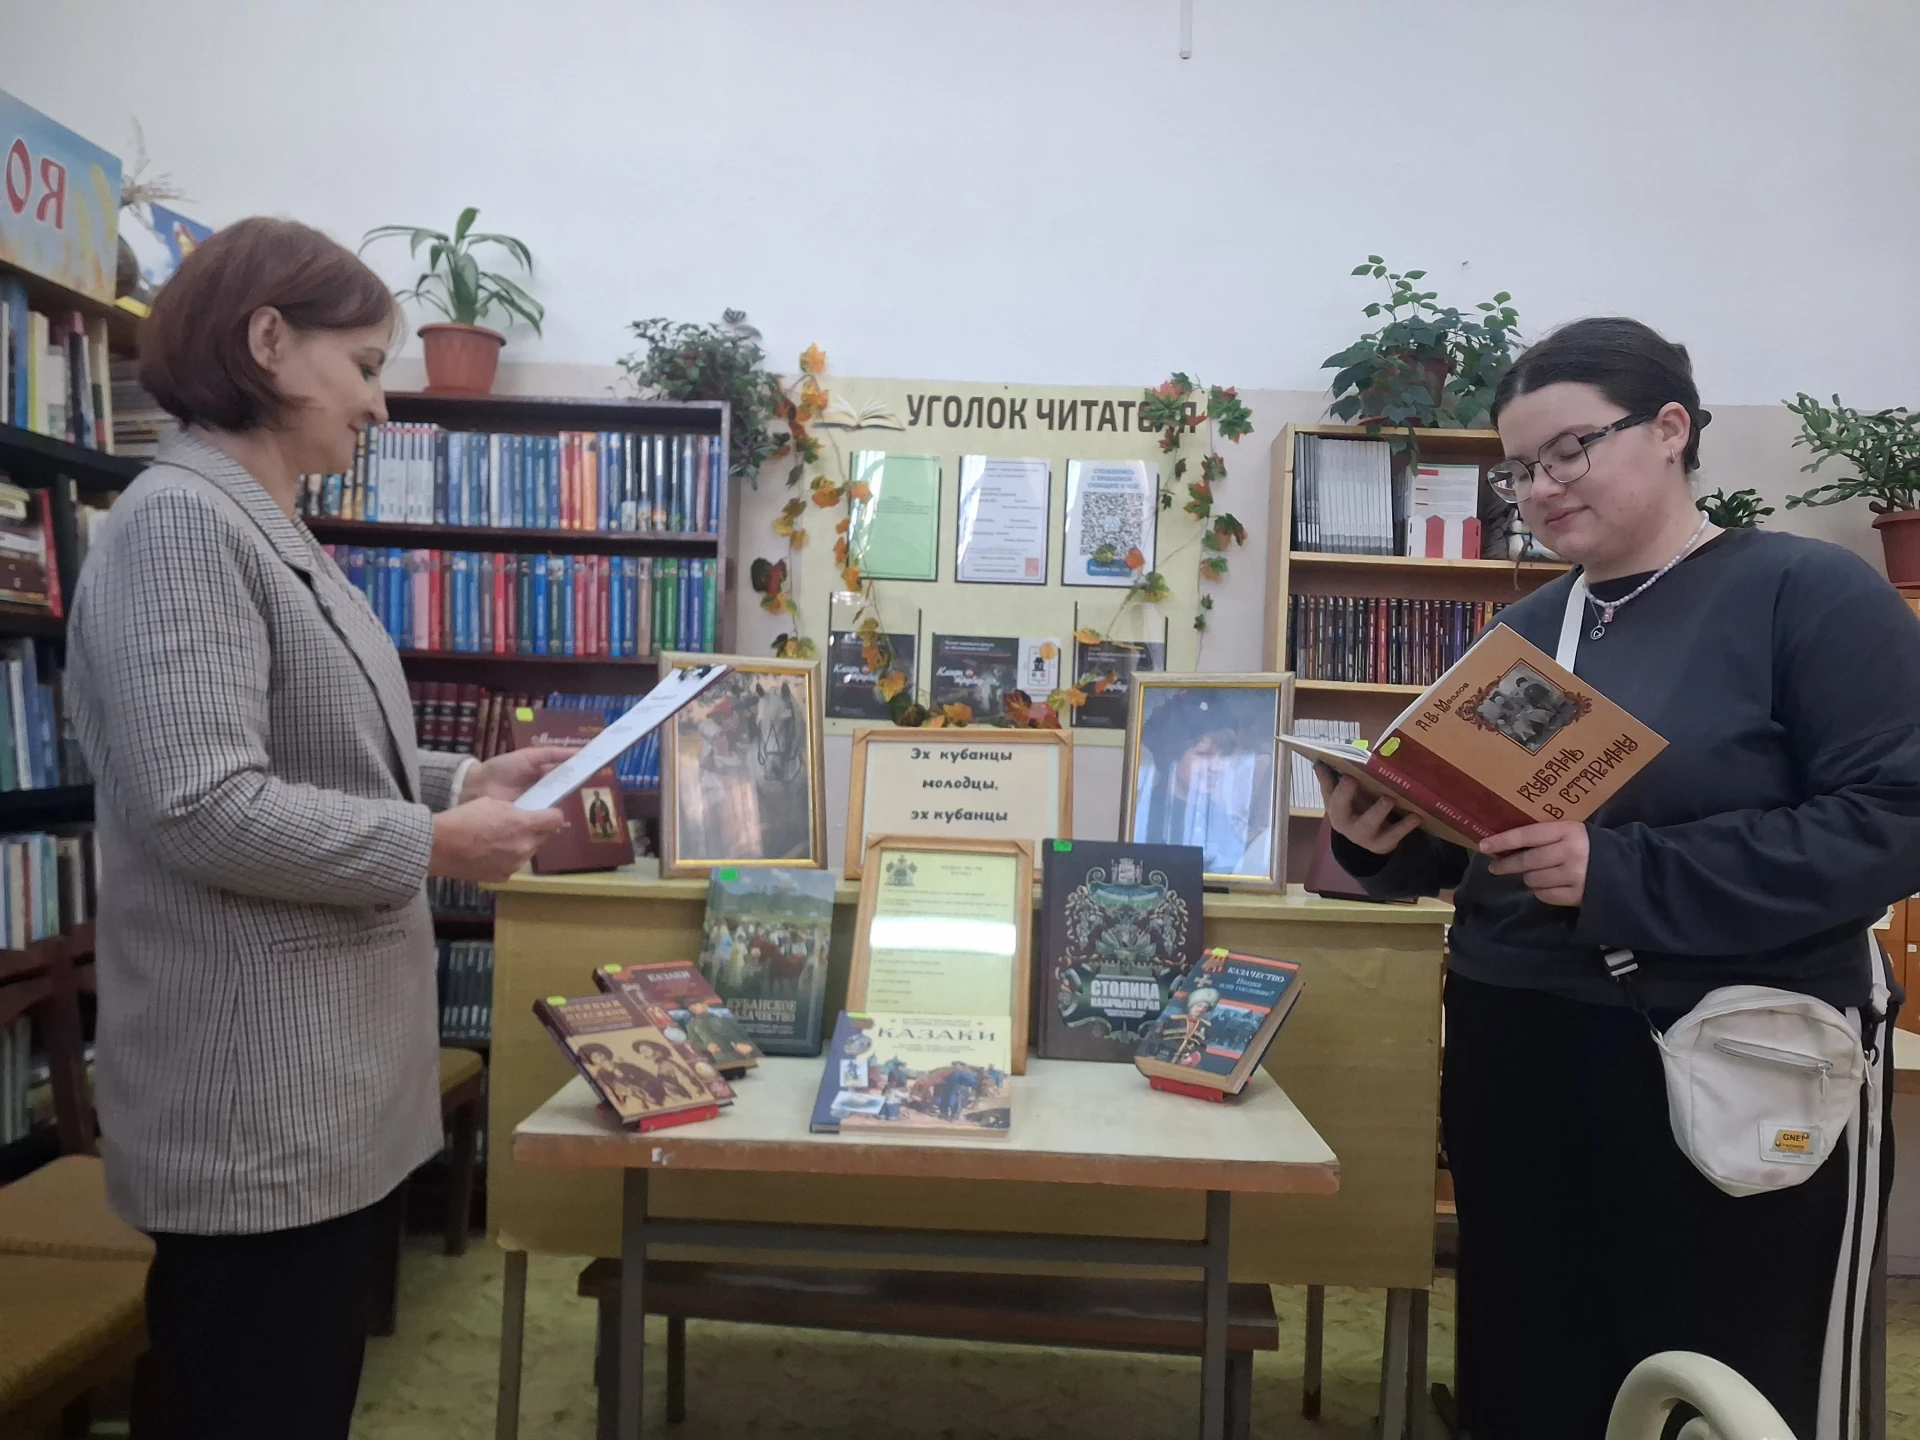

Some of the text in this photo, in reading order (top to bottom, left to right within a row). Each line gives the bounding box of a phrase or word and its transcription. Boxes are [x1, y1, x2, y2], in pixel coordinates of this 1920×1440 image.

[906, 394, 1197, 434] УГОЛОК ЧИТАТЕЯ
[910, 747, 1013, 764] Эх кубанцы
[1516, 748, 1585, 803] КУБАНЬ
[1542, 733, 1638, 820] В СТАРИНУ
[910, 807, 1008, 824] эх кубанцы
[1227, 966, 1285, 983] КАЗАЧЕСТВО
[1090, 979, 1160, 999] СТОЛИЦА
[877, 1027, 996, 1042] КАЗАКИ
